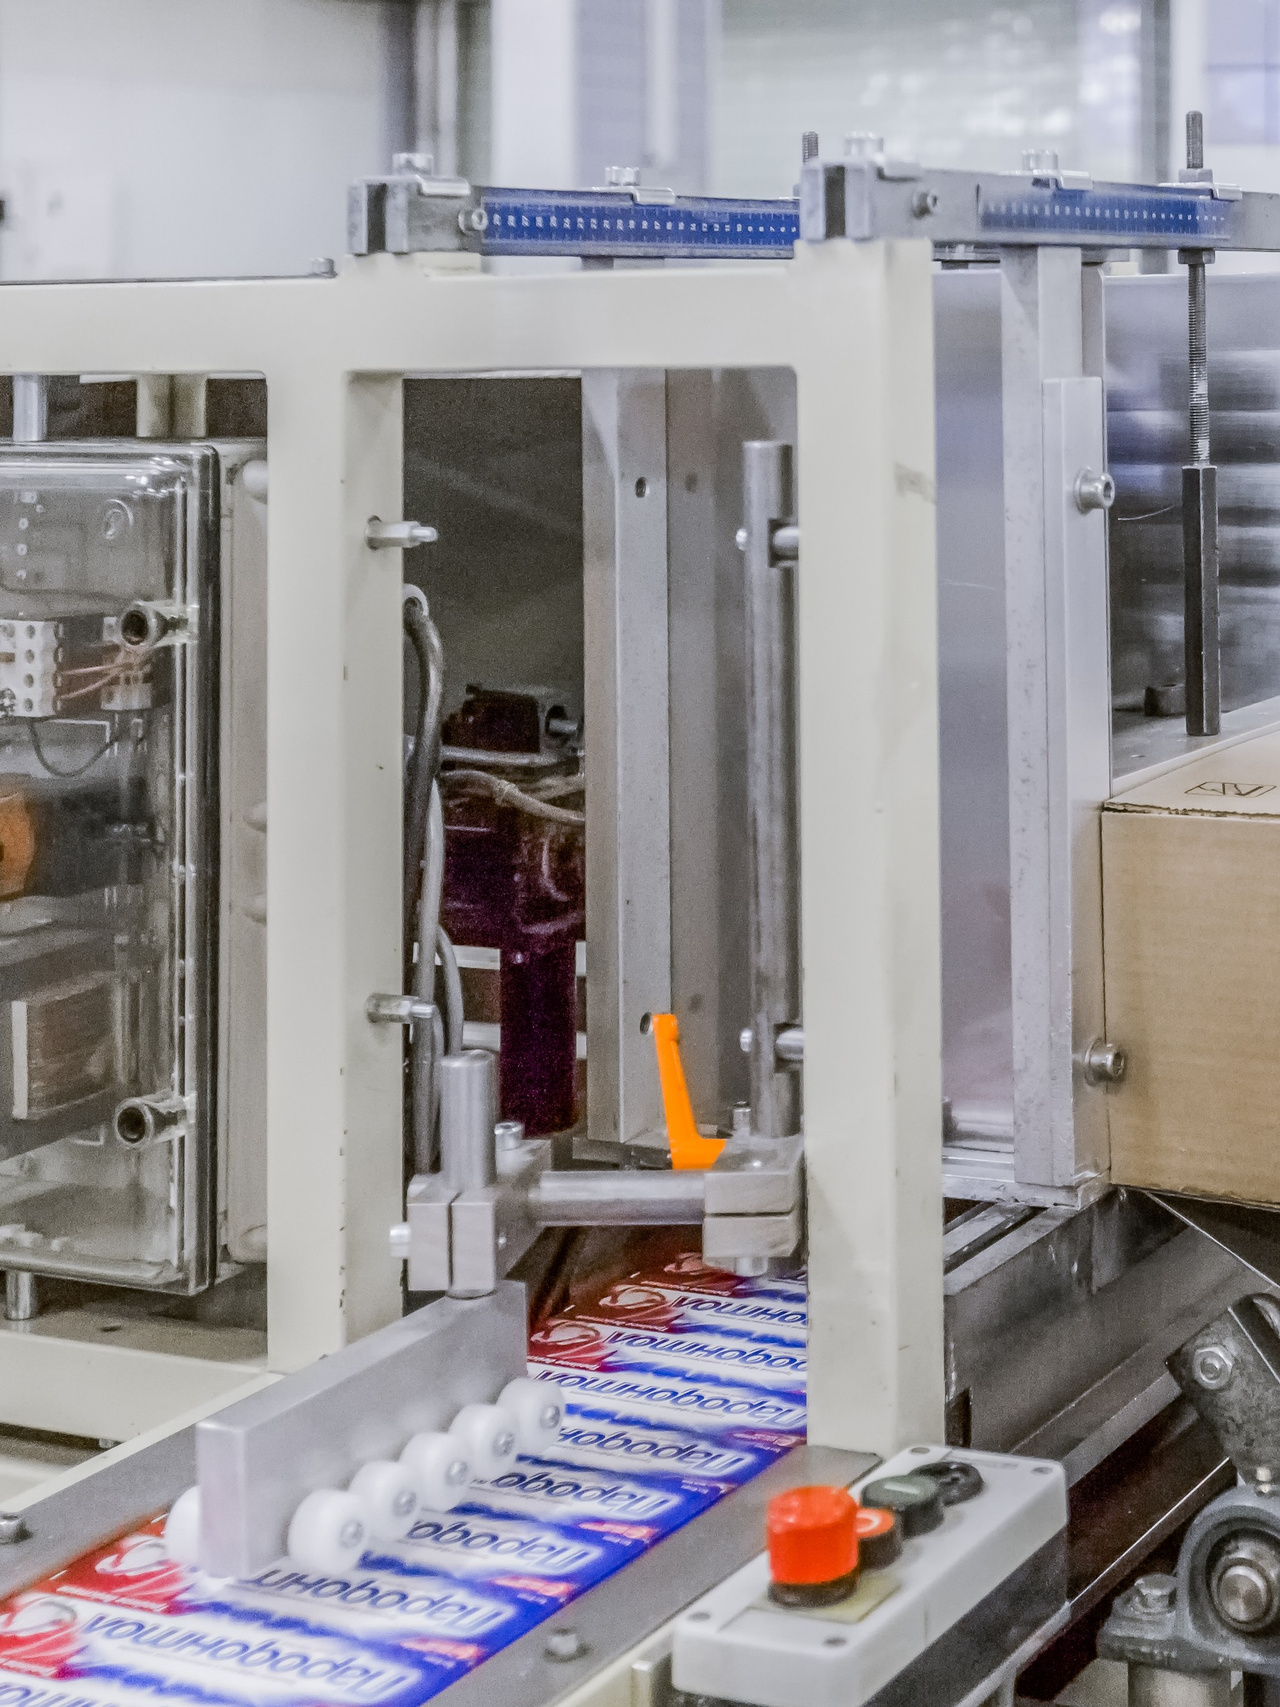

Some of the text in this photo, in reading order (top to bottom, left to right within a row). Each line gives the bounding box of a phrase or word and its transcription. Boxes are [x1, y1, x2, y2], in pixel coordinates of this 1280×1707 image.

[670, 1295, 807, 1326] онтол
[603, 1331, 807, 1373] одонтол
[534, 1370, 807, 1427] Пародонтол
[560, 1425, 748, 1473] Пародон
[491, 1472, 672, 1517] Пародо
[406, 1520, 591, 1570] Пародо
[252, 1569, 510, 1633] Пародонт
[83, 1613, 410, 1697] Пародонтол
